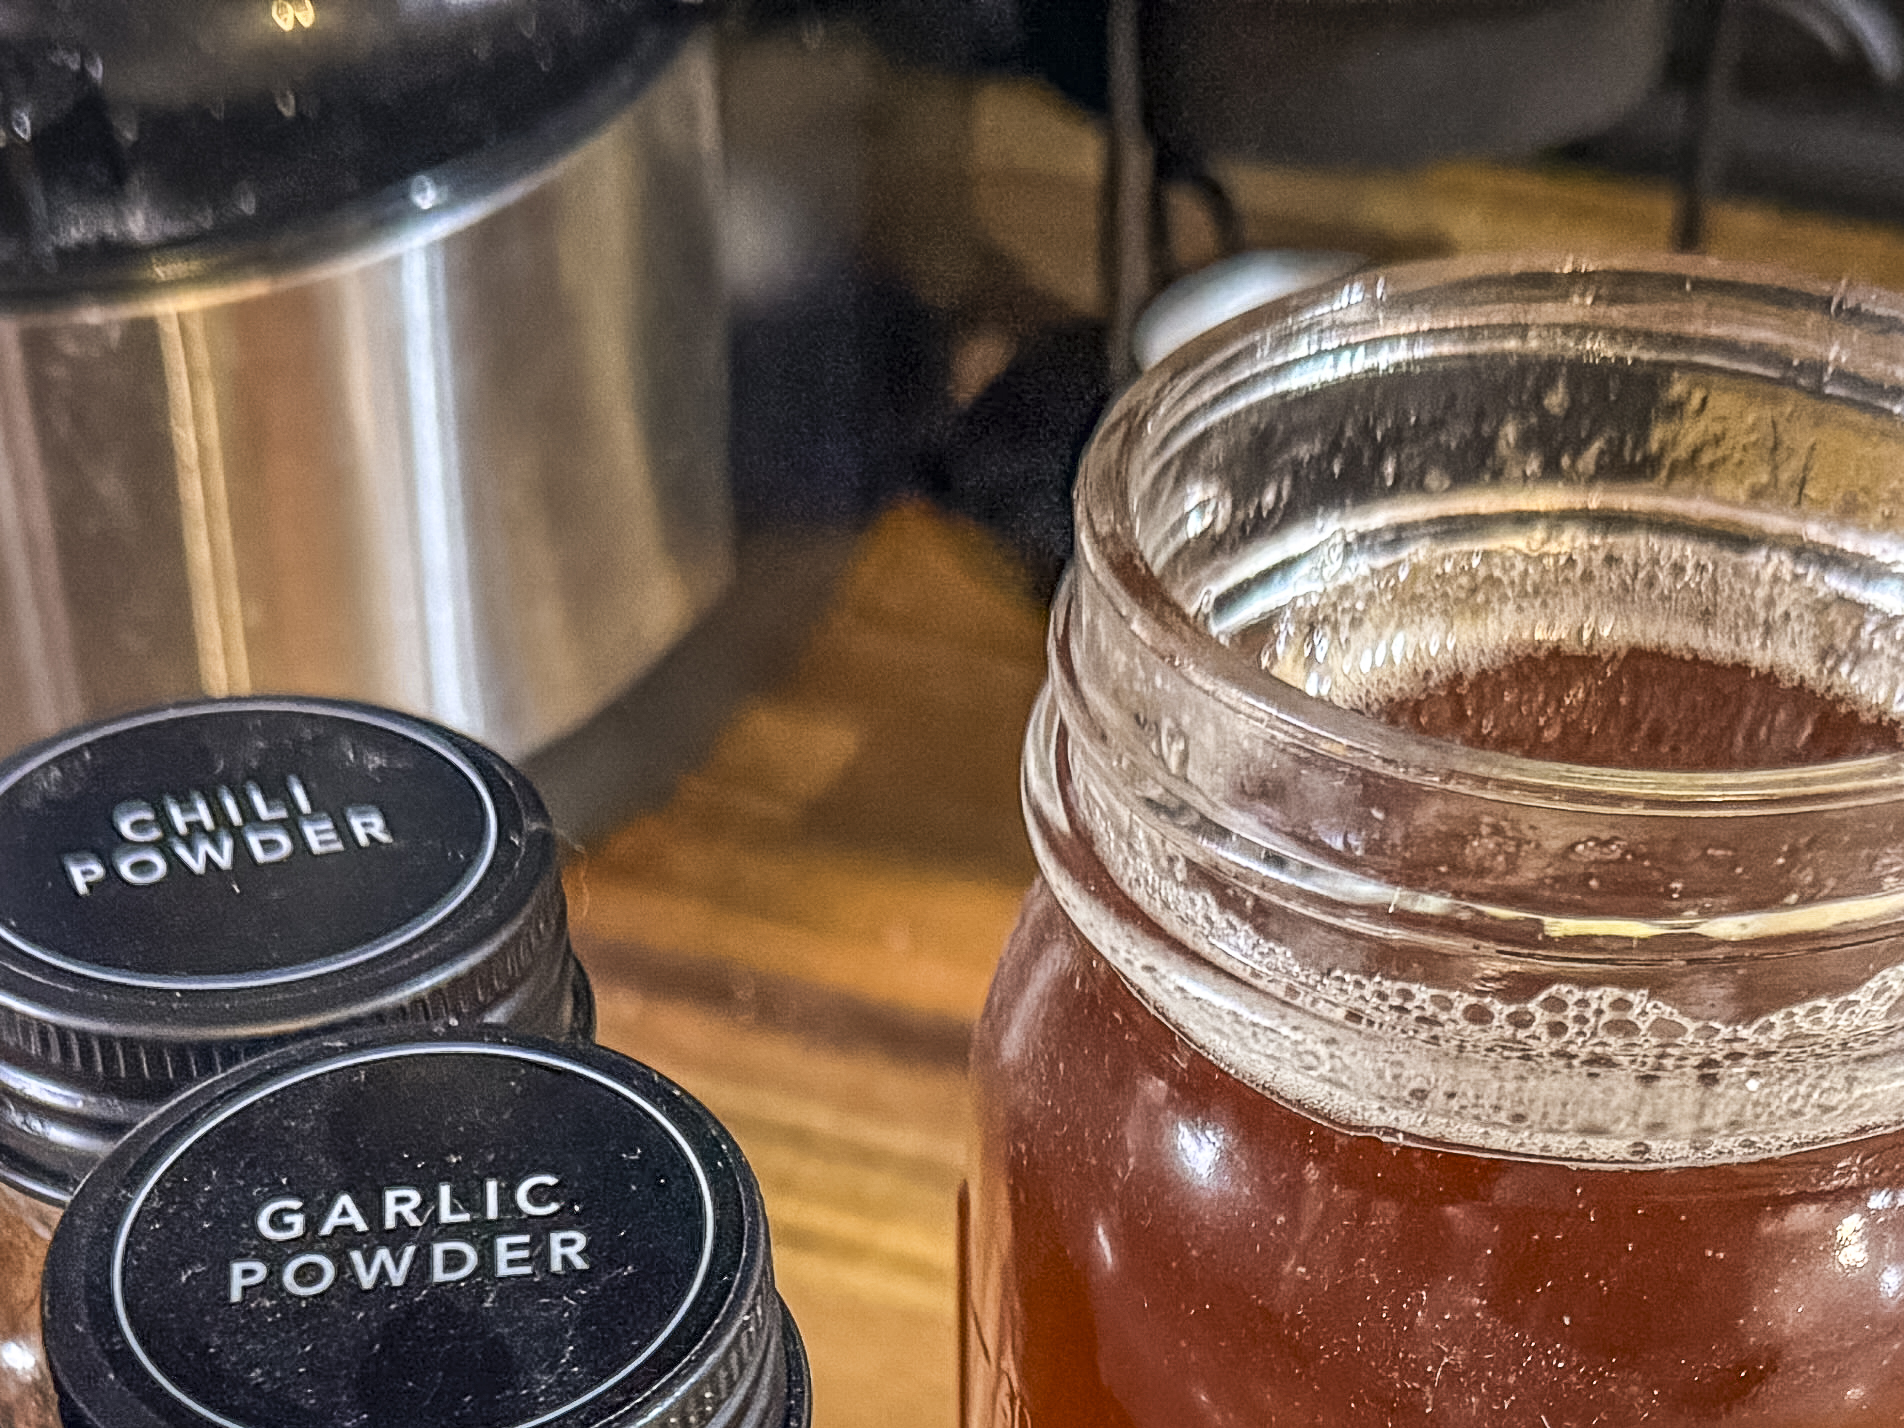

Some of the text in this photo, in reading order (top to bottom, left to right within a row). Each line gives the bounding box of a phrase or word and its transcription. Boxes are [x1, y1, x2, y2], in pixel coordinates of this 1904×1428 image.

[112, 773, 315, 844] CHILI
[63, 804, 395, 897] POWDER
[255, 1173, 563, 1242] GARLIC
[228, 1230, 592, 1304] POWDER
